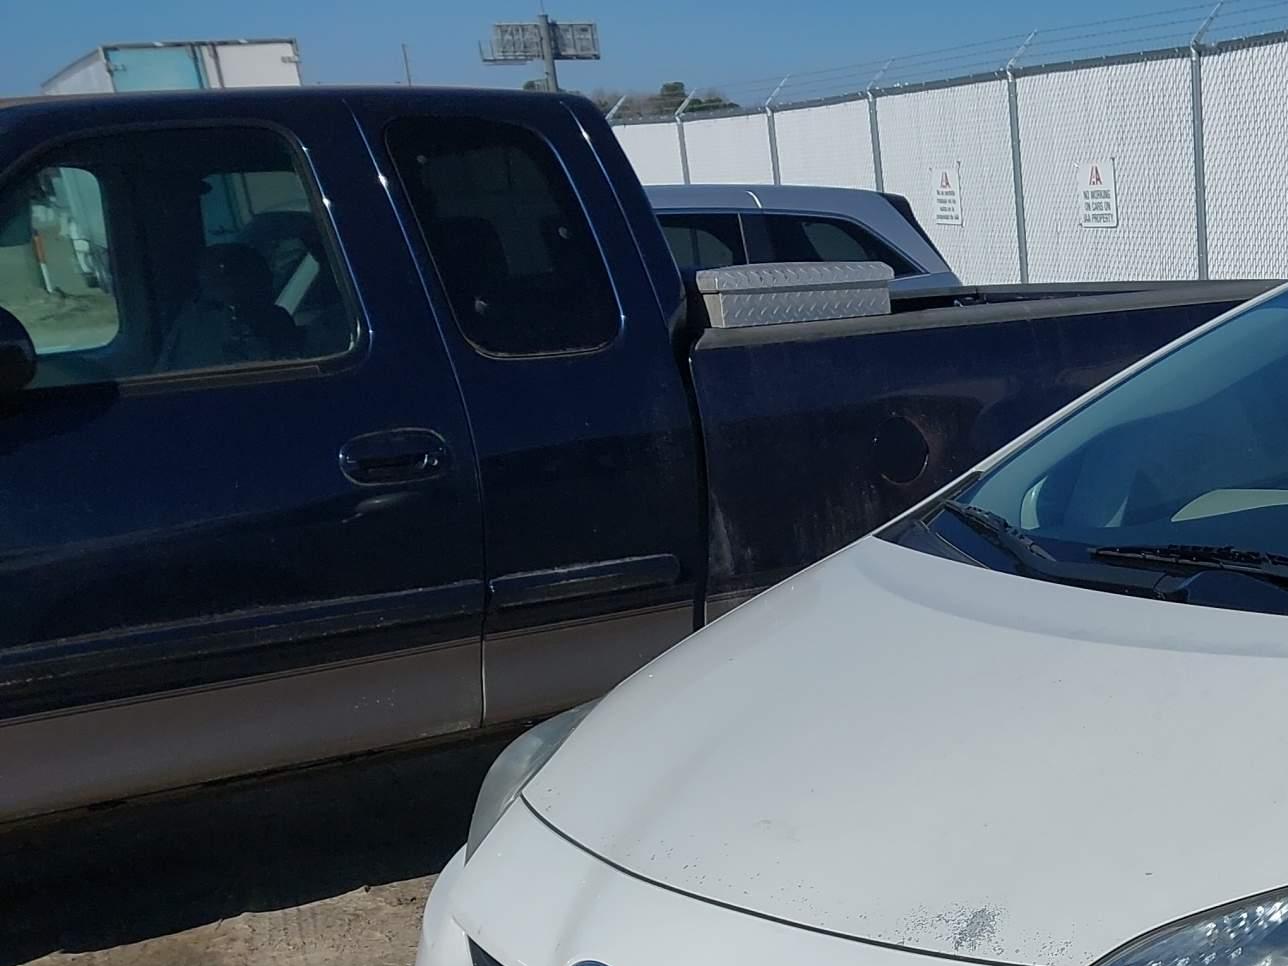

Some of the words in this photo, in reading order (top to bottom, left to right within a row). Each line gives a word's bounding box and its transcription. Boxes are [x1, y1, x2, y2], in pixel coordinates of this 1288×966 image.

[1091, 190, 1111, 199] WORKING
[1092, 202, 1104, 211] CARS
[1092, 213, 1113, 223] PROPERTY
